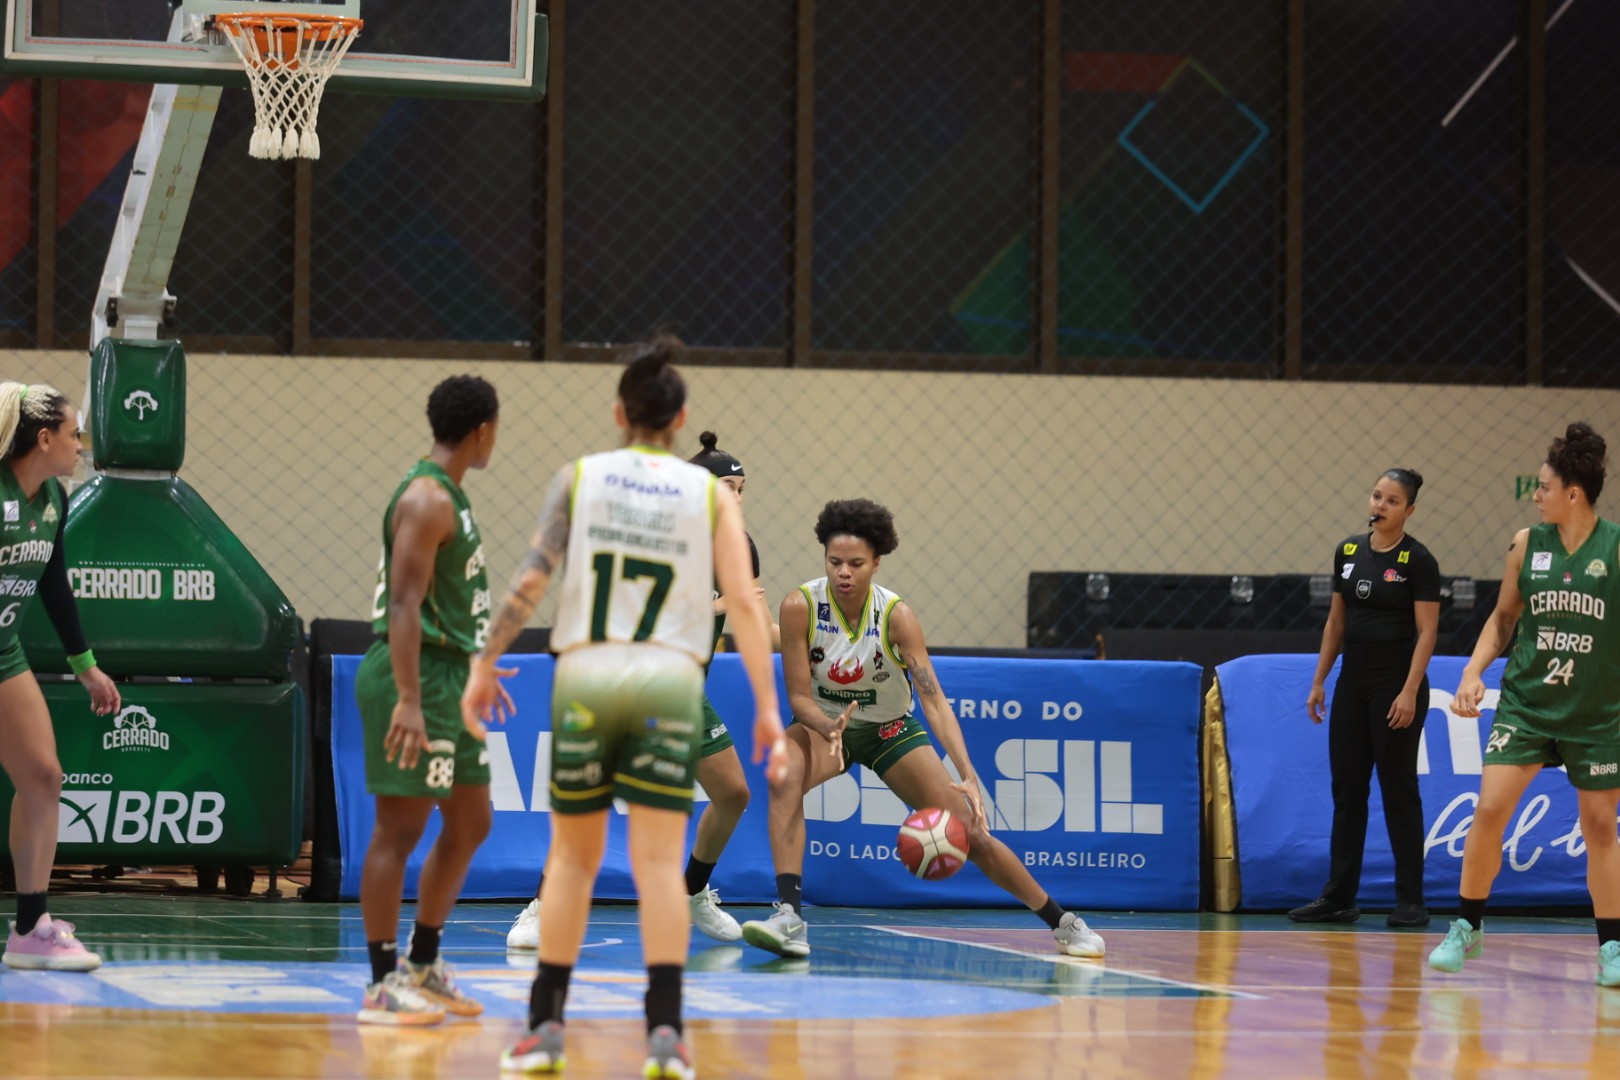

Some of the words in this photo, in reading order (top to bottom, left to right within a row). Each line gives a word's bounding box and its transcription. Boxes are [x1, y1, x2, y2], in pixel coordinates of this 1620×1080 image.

[0, 540, 54, 566] CERRAD
[10, 579, 37, 597] BR
[67, 567, 161, 599] CERRADO
[173, 569, 216, 600] BRB
[590, 551, 676, 643] 17
[1530, 590, 1605, 620] CERRADO
[1554, 631, 1593, 653] BRB
[1543, 657, 1574, 686] 24
[1042, 701, 1083, 721] DO
[103, 728, 170, 750] CERRADO
[1485, 730, 1511, 754] 24
[425, 756, 455, 788] 88
[1600, 763, 1618, 775] BRB
[112, 790, 226, 844] BRB
[810, 840, 841, 858] DO
[1024, 851, 1146, 869] BRASILEIRO
